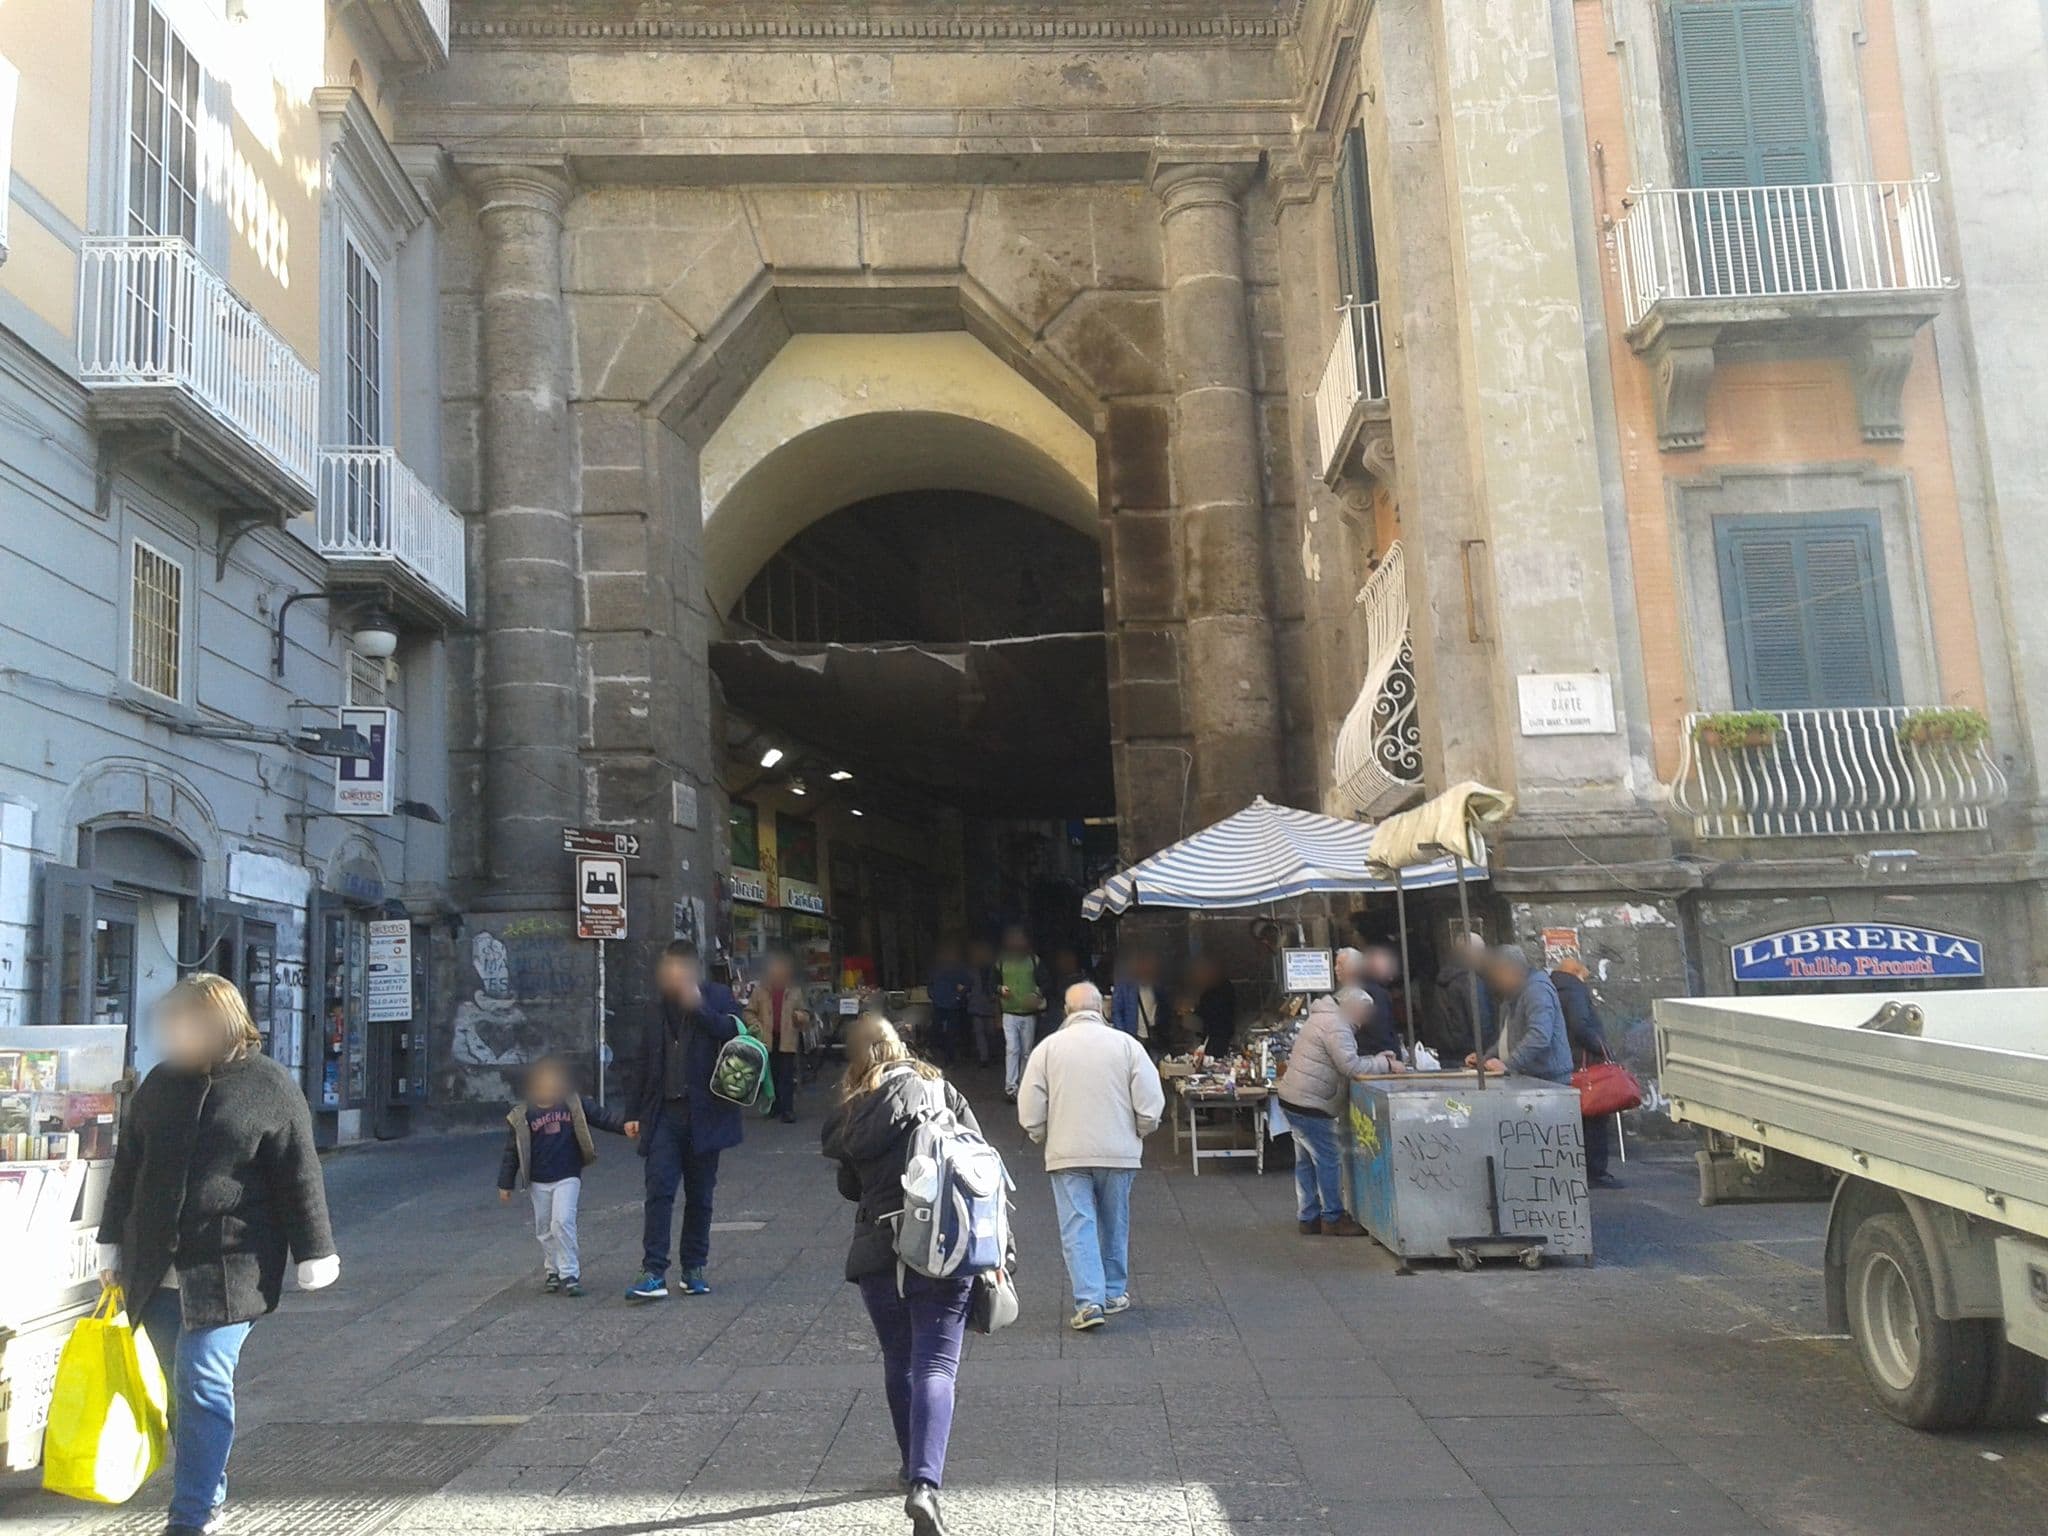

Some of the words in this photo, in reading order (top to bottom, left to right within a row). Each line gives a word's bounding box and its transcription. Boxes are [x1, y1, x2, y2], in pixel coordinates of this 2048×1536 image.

[1742, 927, 1979, 968] LIBRERIA
[1785, 957, 1851, 977] Tullio
[1856, 956, 1935, 976] Pironti
[1499, 1119, 1585, 1146] PAVEL
